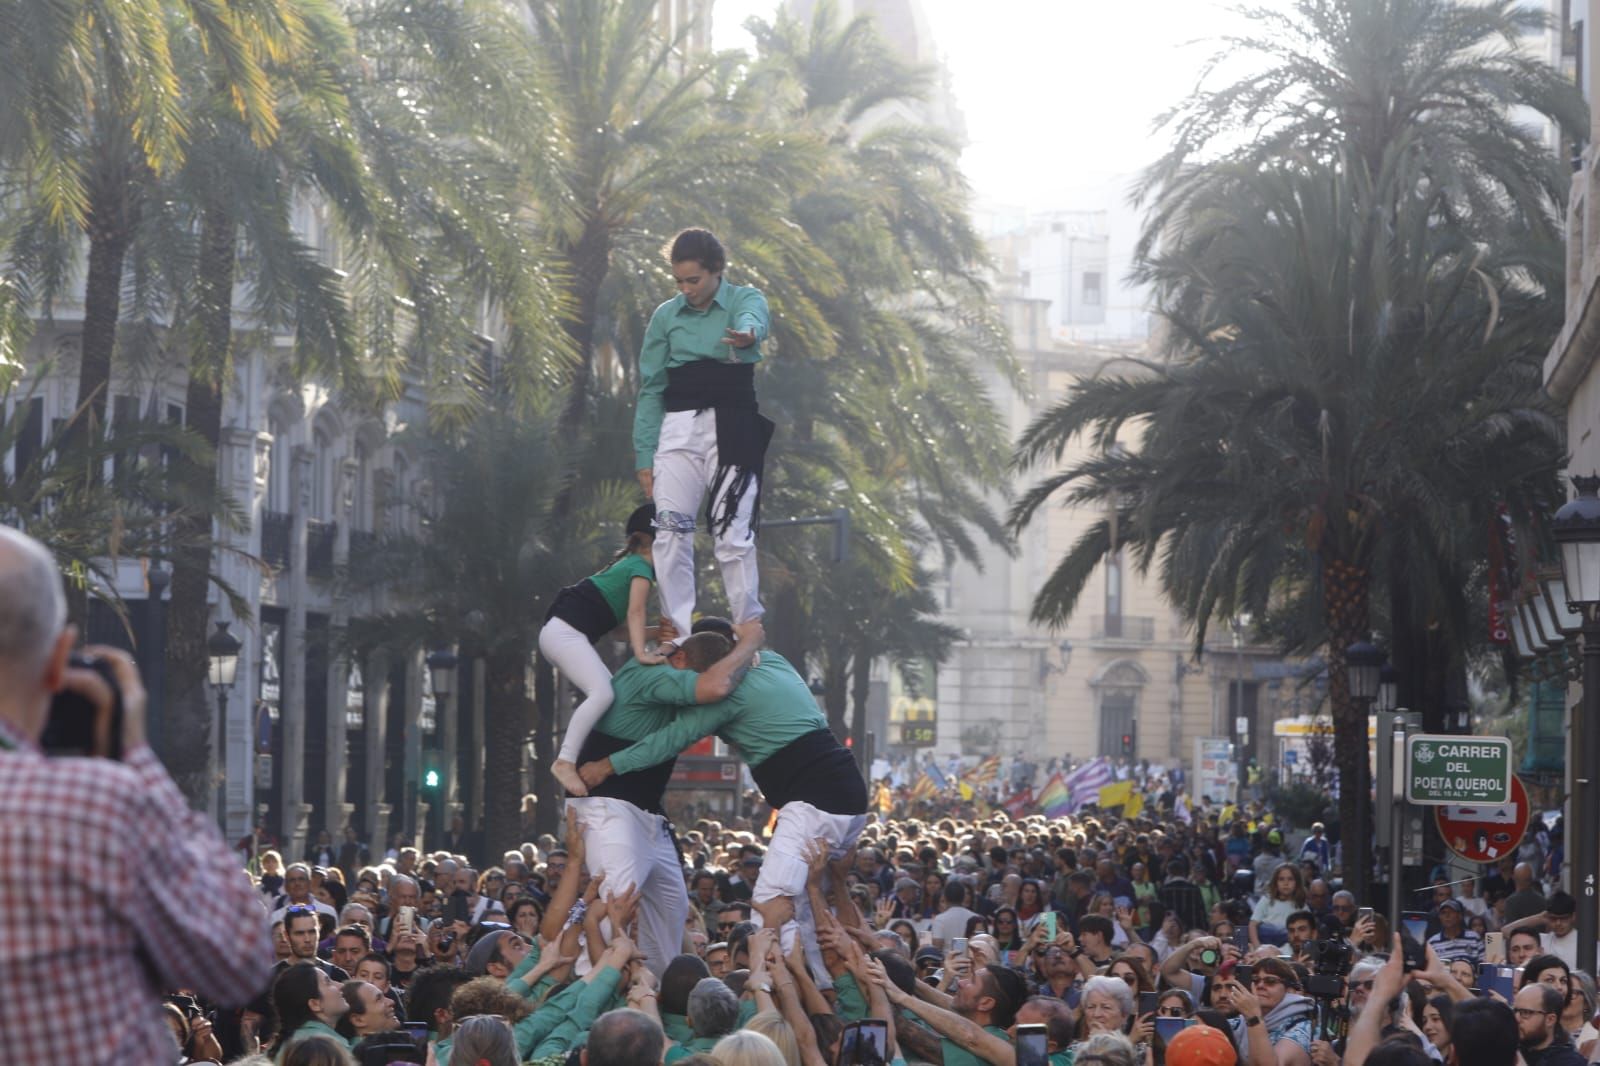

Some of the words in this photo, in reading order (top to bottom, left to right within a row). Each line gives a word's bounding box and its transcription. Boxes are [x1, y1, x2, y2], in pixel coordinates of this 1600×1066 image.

[1438, 745, 1501, 758] CARRER
[1446, 762, 1471, 772] DEL
[1414, 777, 1452, 789] POETA
[1455, 778, 1503, 791] QUEROL
